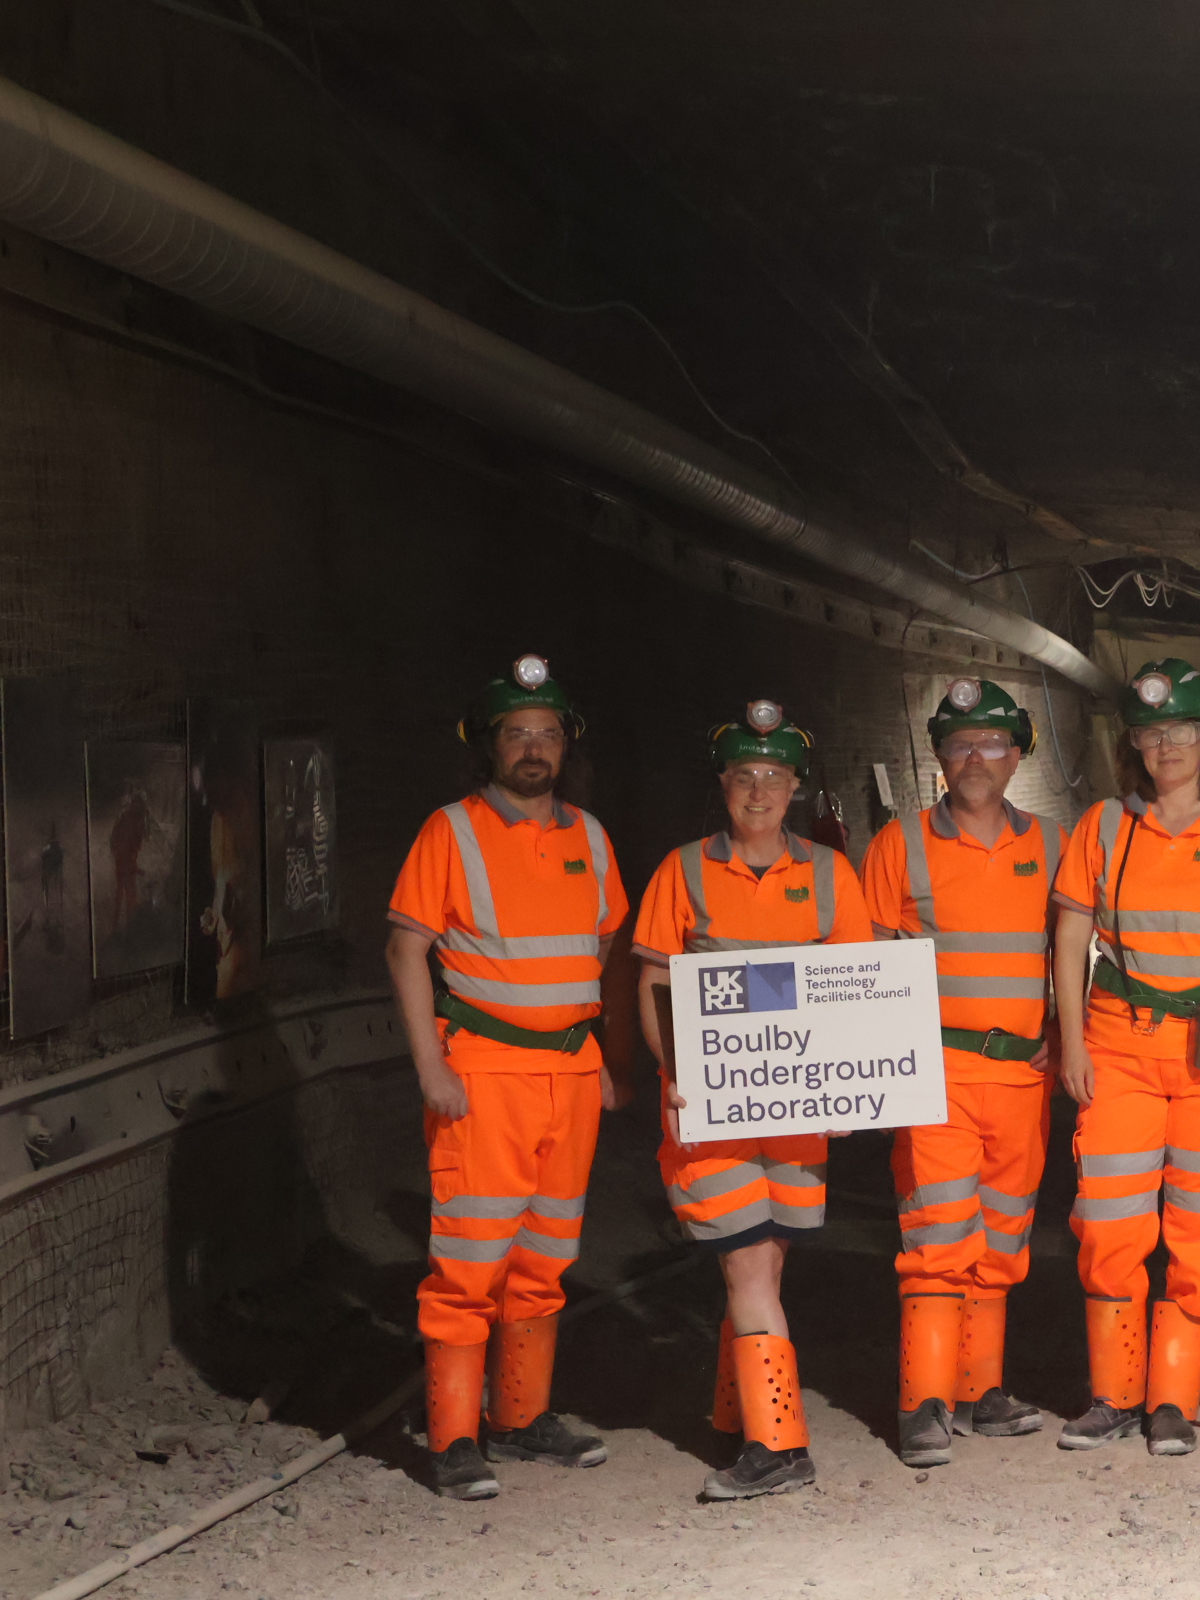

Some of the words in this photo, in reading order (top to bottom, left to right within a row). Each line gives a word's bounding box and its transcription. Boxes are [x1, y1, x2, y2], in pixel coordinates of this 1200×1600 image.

[805, 964, 854, 976] Science
[857, 961, 881, 972] and
[805, 977, 876, 991] Technology
[806, 991, 861, 1004] Facilities
[864, 986, 911, 1000] Council
[702, 1025, 811, 1056] Boulby
[704, 1049, 917, 1090] Underground
[706, 1093, 885, 1125] Laboratory
